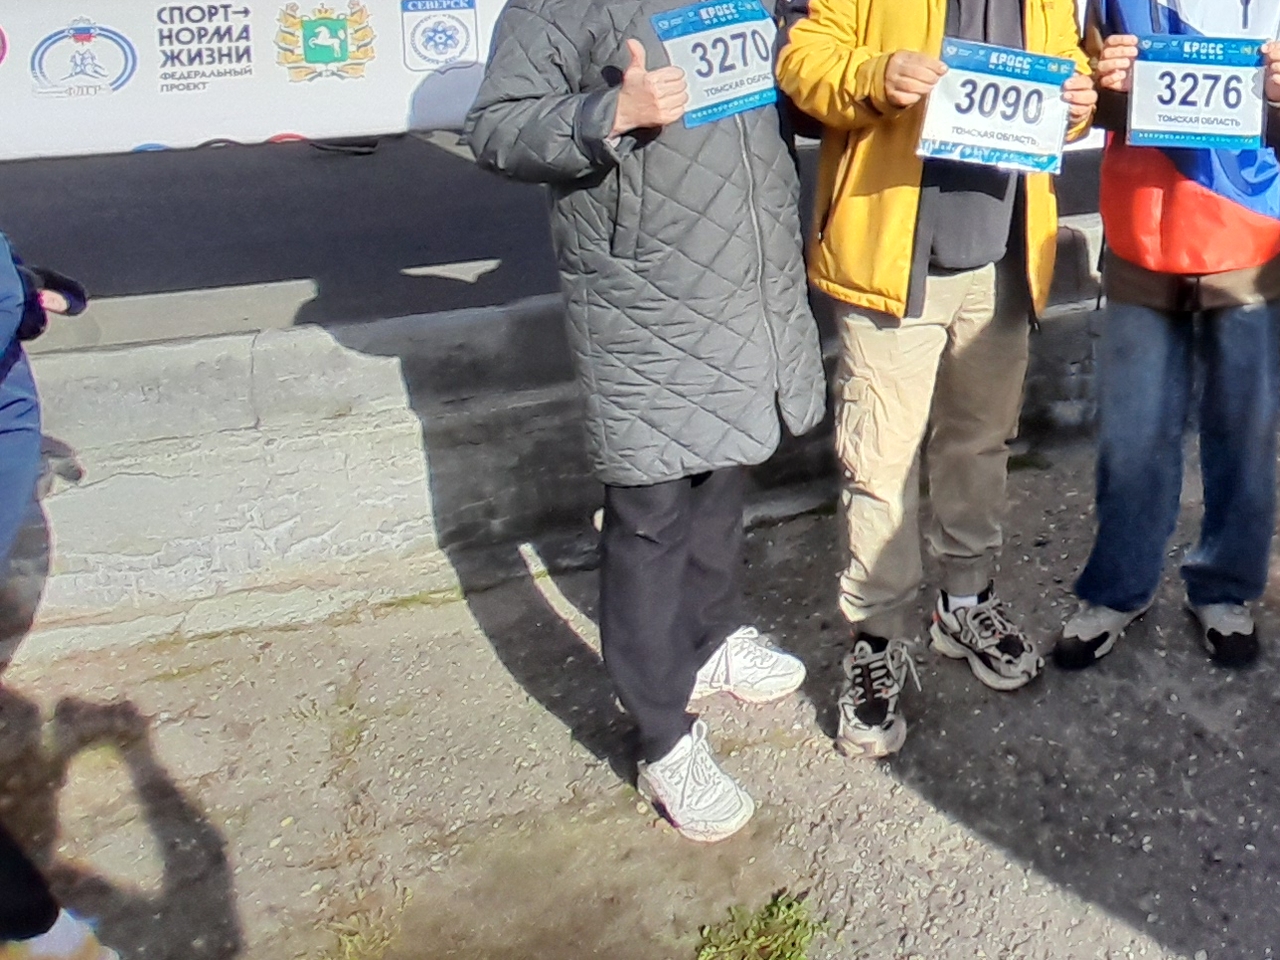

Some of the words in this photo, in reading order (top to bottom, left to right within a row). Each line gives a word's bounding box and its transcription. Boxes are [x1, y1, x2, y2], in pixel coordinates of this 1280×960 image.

[157, 3, 232, 25] СПОРТ
[700, 2, 738, 20] КРОСС
[157, 24, 251, 47] НОРМА
[159, 45, 252, 68] ЖИЗНИ
[691, 29, 770, 78] 3270
[1183, 41, 1224, 55] КРОСС
[989, 52, 1033, 69] КРОСС
[160, 65, 253, 80] ФЕДЕРАЛЬНЫЙ
[160, 81, 210, 92] ПРОЕКТ
[704, 78, 745, 97] ТОМСКАЯ
[1157, 70, 1244, 110] 3276
[954, 78, 1044, 125] 3090
[1157, 114, 1200, 125] ТОМСКАЯ
[1201, 117, 1241, 127] ОБЛАСТЬ
[951, 126, 995, 139] ТОМСКАЯ
[995, 132, 1037, 146] ОБЛАСТЬ
